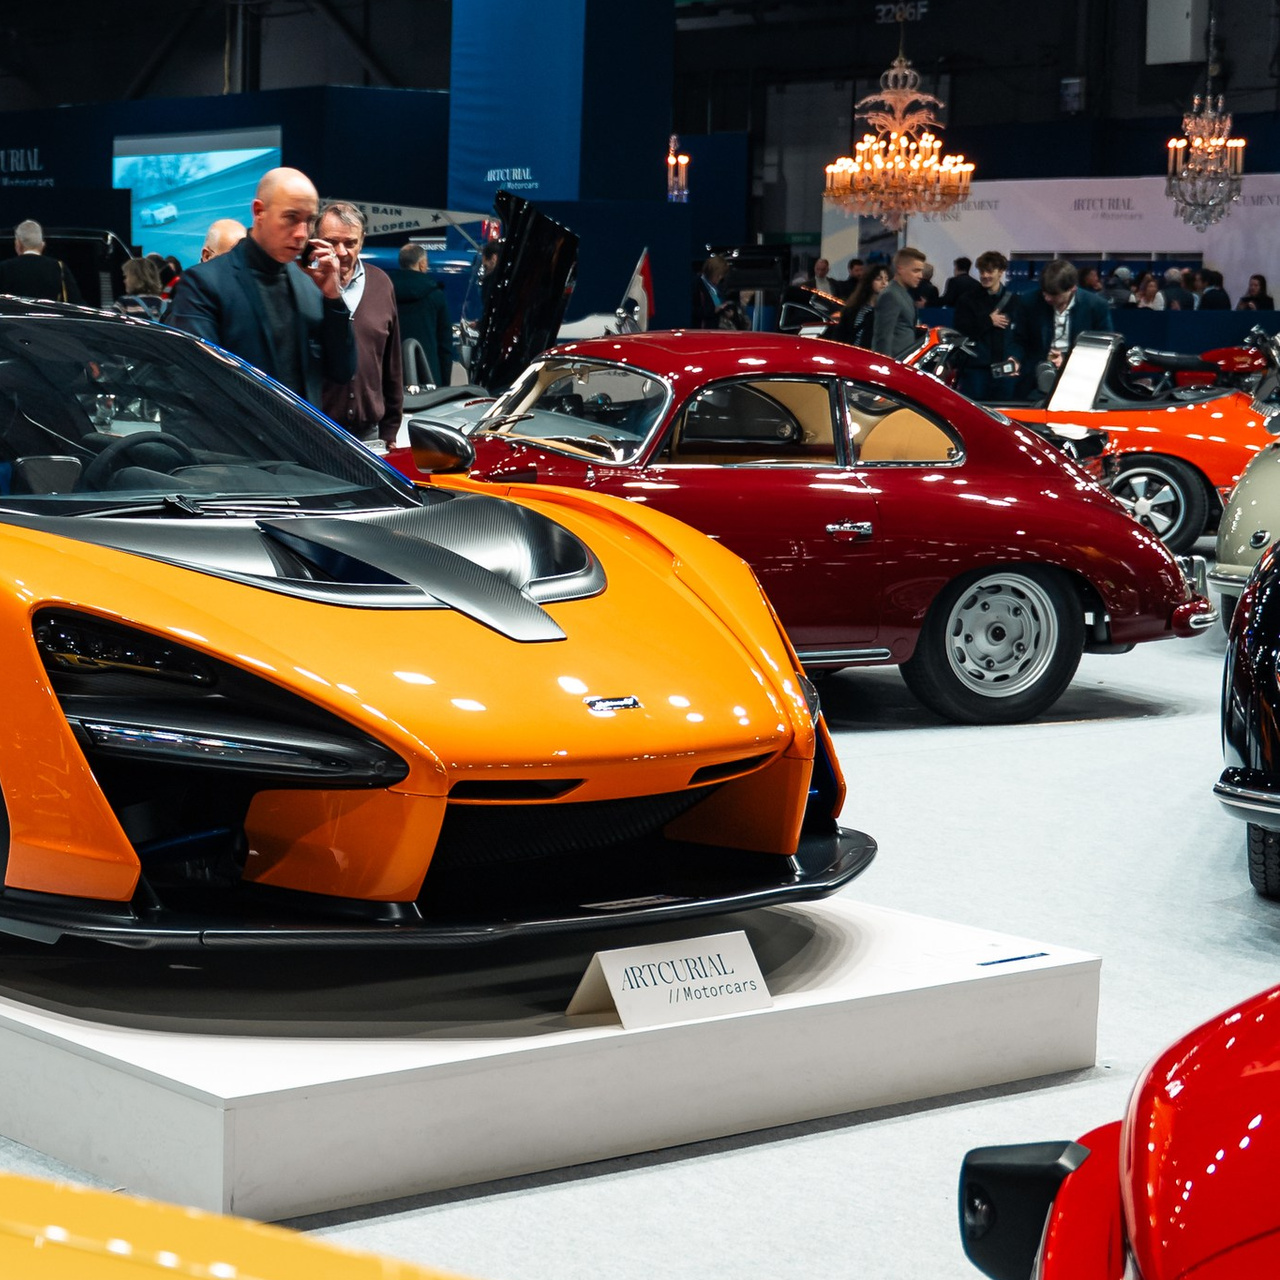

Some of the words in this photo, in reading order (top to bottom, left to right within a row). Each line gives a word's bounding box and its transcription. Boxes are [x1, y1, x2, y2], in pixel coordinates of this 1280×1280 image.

[484, 167, 532, 182] ARTCURIAL
[372, 206, 402, 216] BAIN
[622, 953, 735, 991] ARTCURIAL
